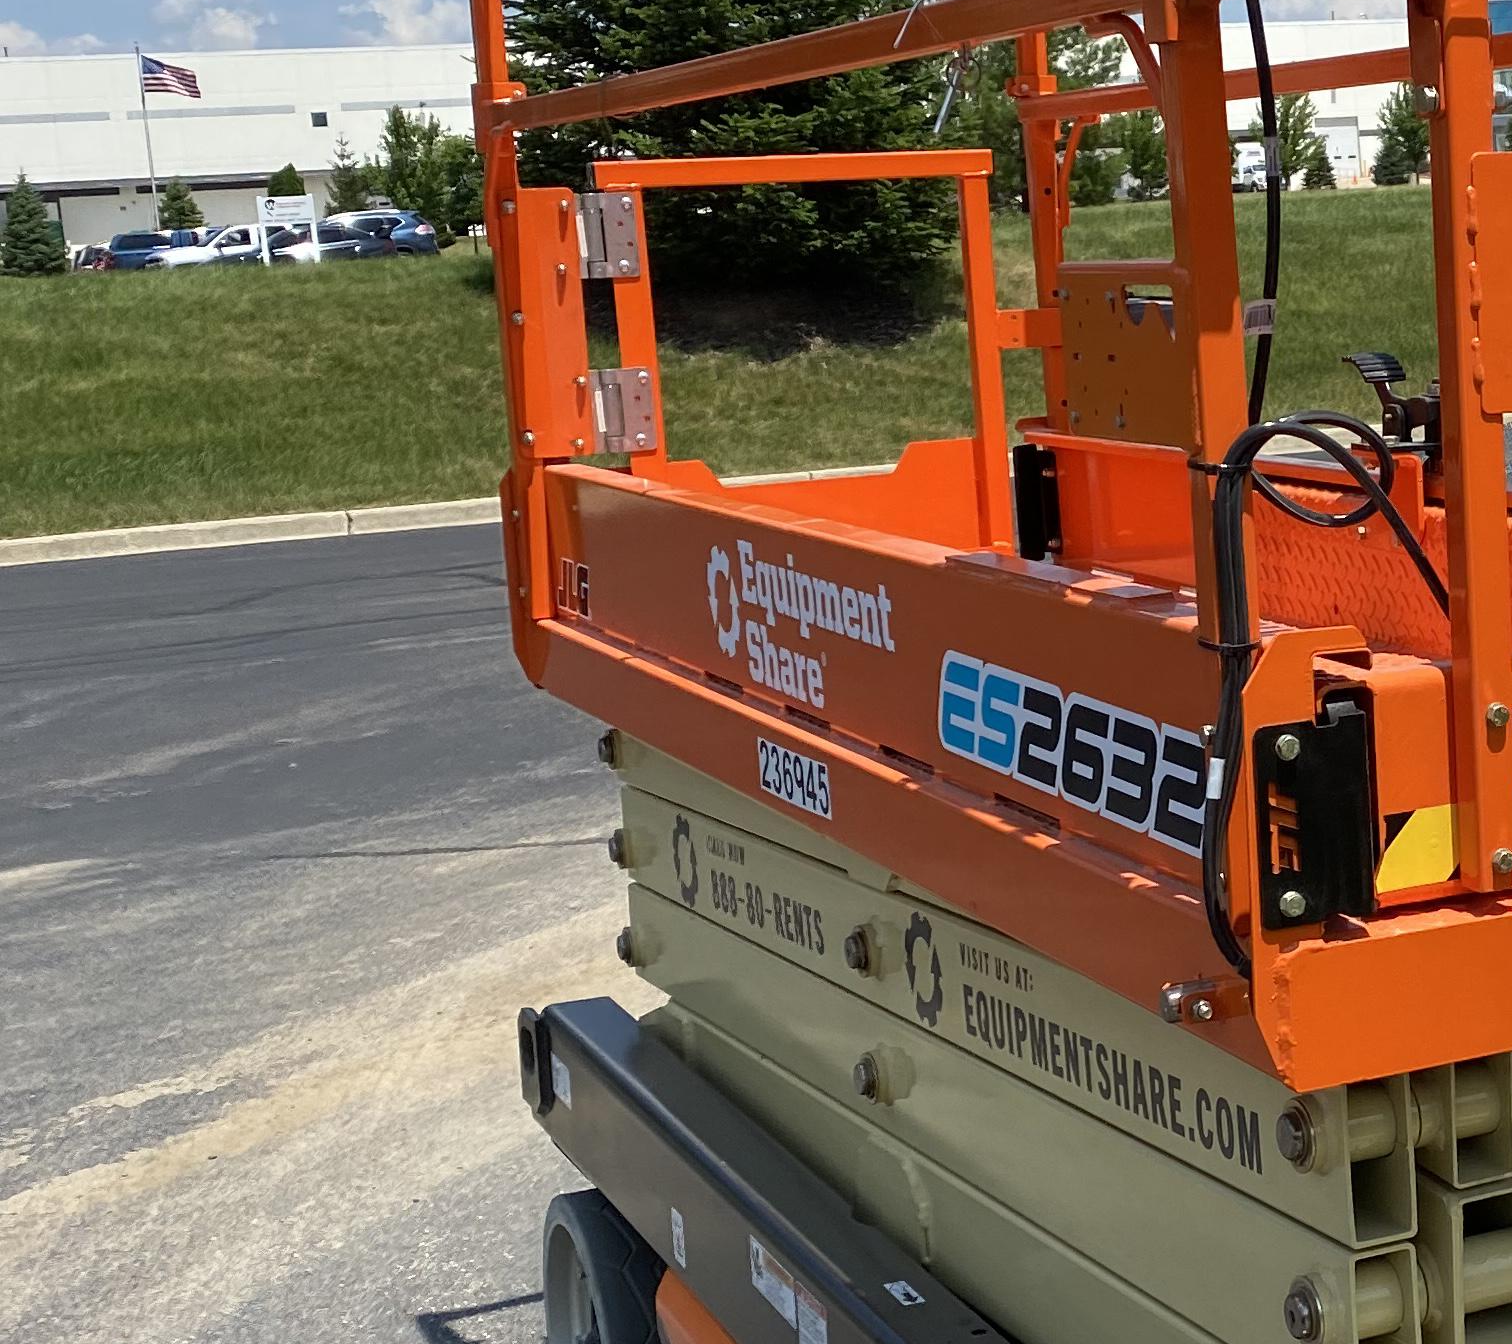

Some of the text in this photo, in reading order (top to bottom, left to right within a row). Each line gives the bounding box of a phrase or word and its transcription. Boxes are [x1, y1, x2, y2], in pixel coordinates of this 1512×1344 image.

[737, 539, 895, 652] Equipment
[746, 619, 825, 709] Share
[760, 740, 829, 815] 236945
[941, 660, 1207, 850] ES2632
[711, 869, 825, 955] 888-80-RENTS
[959, 942, 1034, 993] VISIT US AT:
[963, 984, 1263, 1175] EQUIPMENTSHARE.COM
